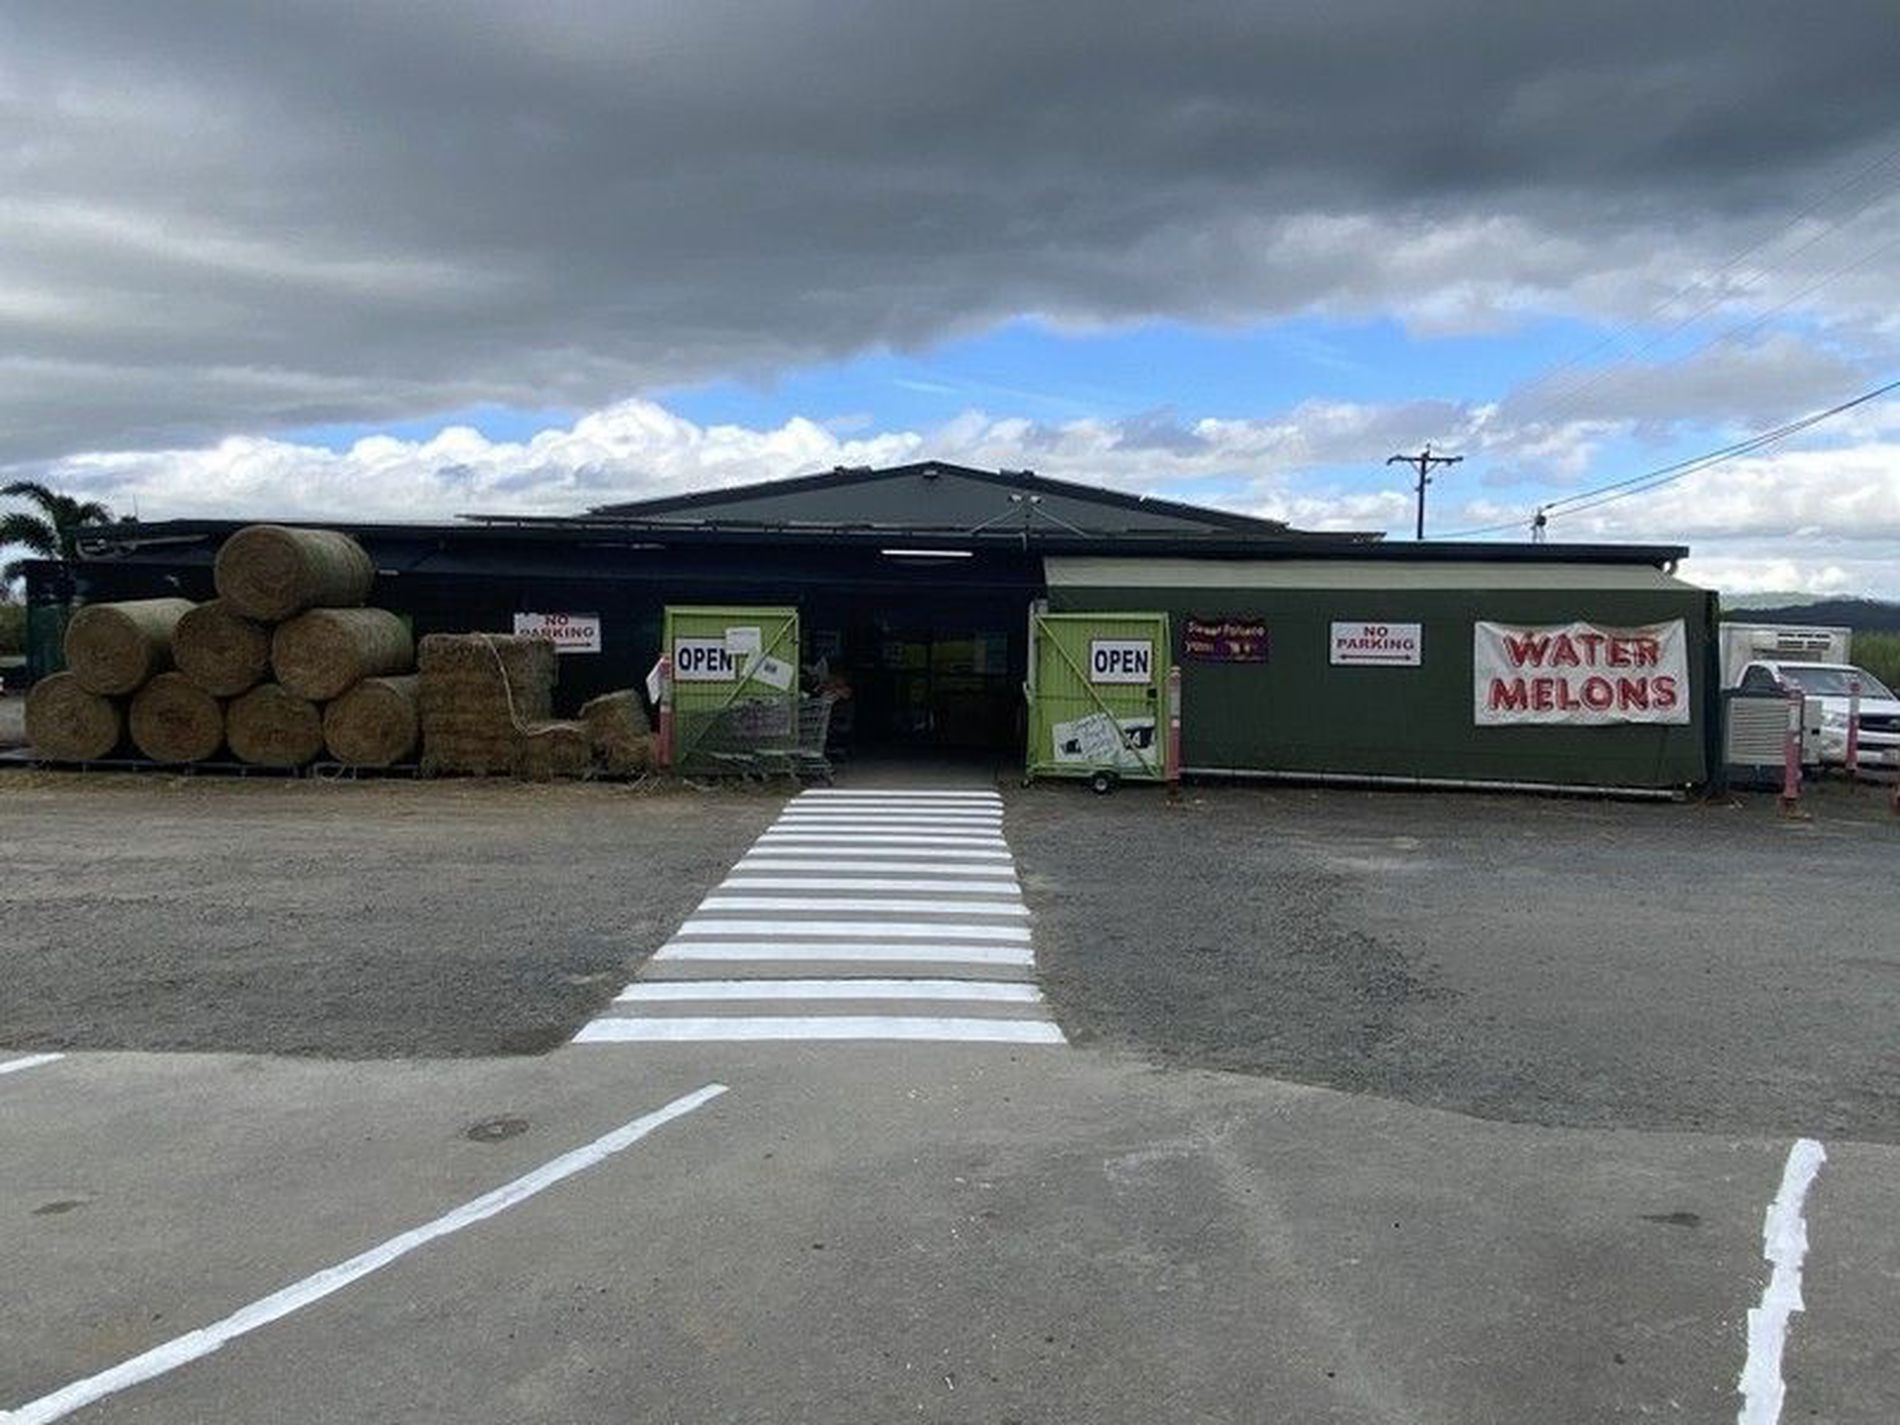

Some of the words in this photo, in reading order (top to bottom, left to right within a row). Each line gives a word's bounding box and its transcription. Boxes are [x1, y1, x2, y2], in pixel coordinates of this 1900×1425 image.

[545, 614, 569, 626] NO
[1364, 626, 1388, 637] NO
[1337, 638, 1414, 650] PARKING
[1503, 632, 1660, 668] WATER
[678, 647, 732, 671] OPEN
[1094, 650, 1149, 673] OPEN
[1489, 675, 1678, 711] MELONS
